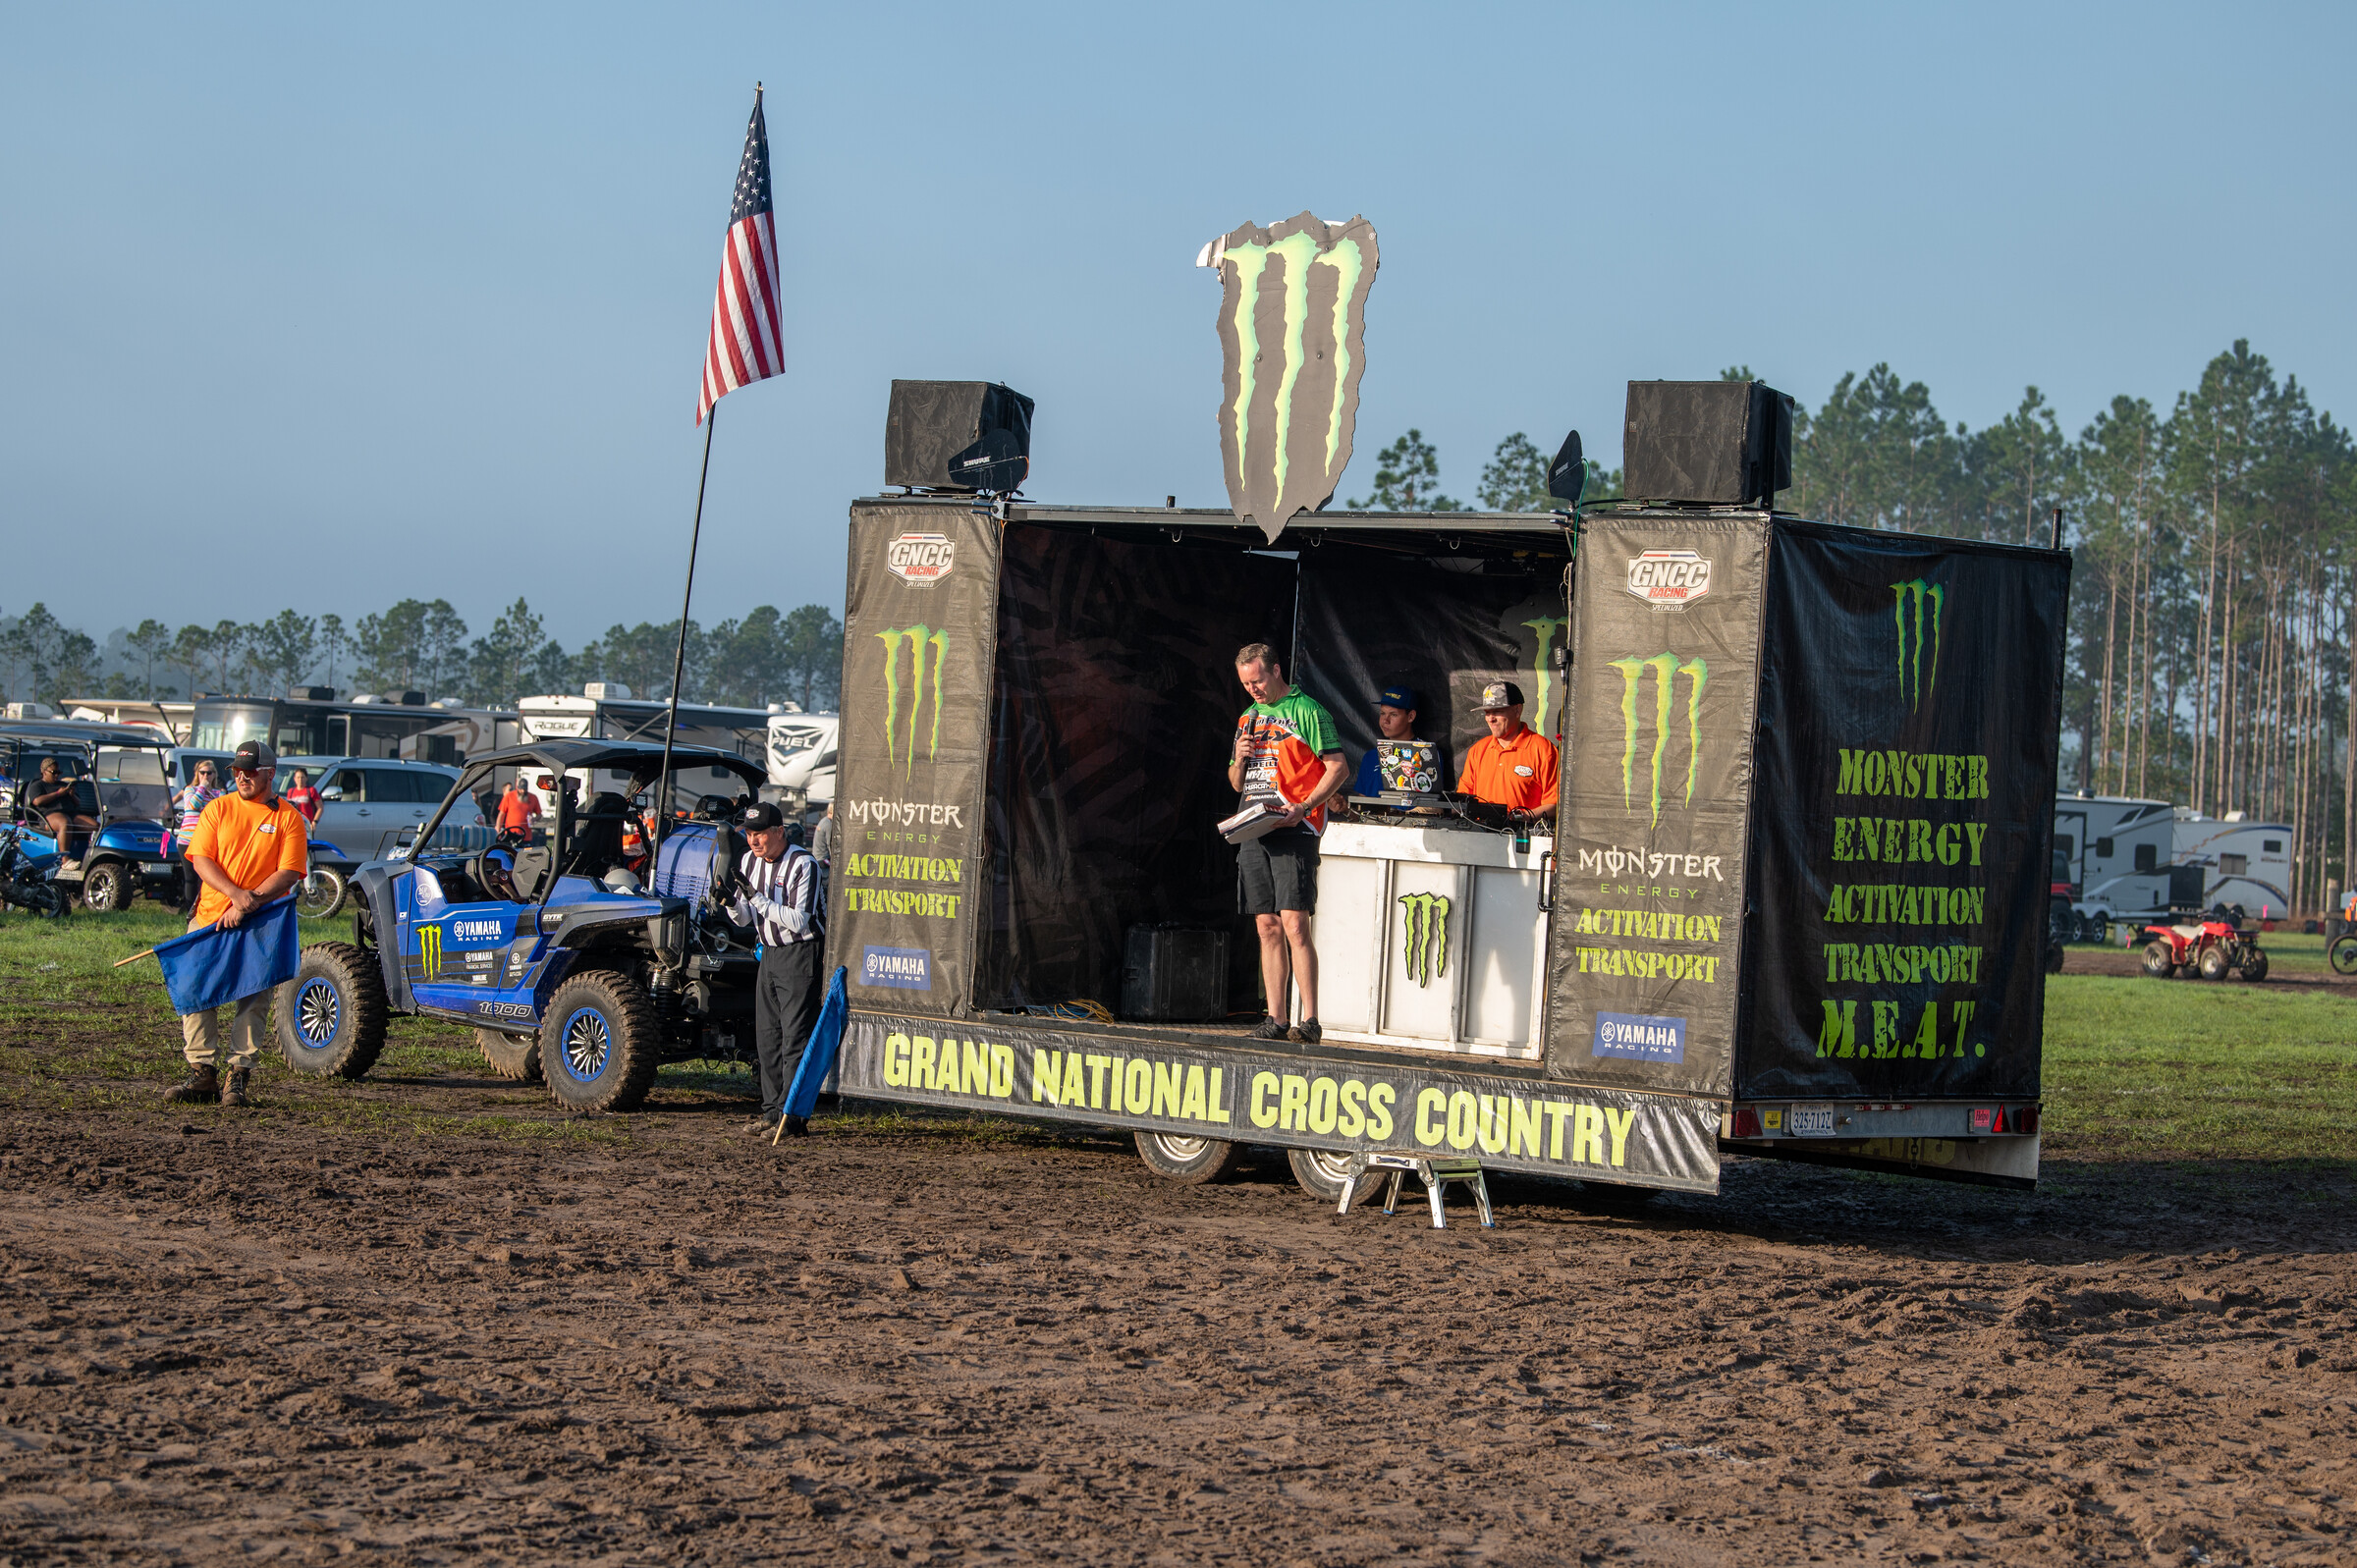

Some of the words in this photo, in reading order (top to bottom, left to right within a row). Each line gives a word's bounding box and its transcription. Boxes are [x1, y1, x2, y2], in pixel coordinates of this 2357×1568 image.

[963, 456, 991, 467] SHURE
[891, 542, 953, 567] GNCC
[904, 566, 940, 576] RACING
[1631, 562, 1709, 587] GNCC
[1648, 587, 1689, 598] RACING
[771, 736, 814, 748] FUEL
[1836, 748, 1990, 800] MONSTER
[849, 797, 963, 829] MONSTER
[867, 831, 941, 844] ENERGY
[1832, 817, 1988, 866] ENERGY
[845, 853, 962, 883] ACTIVATION
[1578, 845, 1724, 882] MONSTER
[845, 888, 960, 919] TRANSPORT
[1601, 883, 1698, 899] ENERGY
[1824, 884, 1985, 925] ACTIVATION
[464, 920, 502, 935] YAMAHA
[1574, 908, 1723, 942] ACTIVATION
[470, 951, 493, 961] YAMAHA
[877, 955, 925, 975] YAMAHA
[1575, 946, 1720, 983] TRANSPORT
[1824, 943, 1983, 984] TRANSPORT
[869, 972, 921, 981] RACING
[479, 1001, 532, 1017] 1000
[1617, 1024, 1677, 1047] YAMAHA
[1816, 1000, 1986, 1059] M.E.A.T.
[1605, 1043, 1672, 1054] RACING
[884, 1033, 1015, 1099] GRAND
[1032, 1049, 1230, 1123] NATIONAL
[1249, 1071, 1396, 1141] CROSS
[1414, 1087, 1636, 1167] COUNTRY
